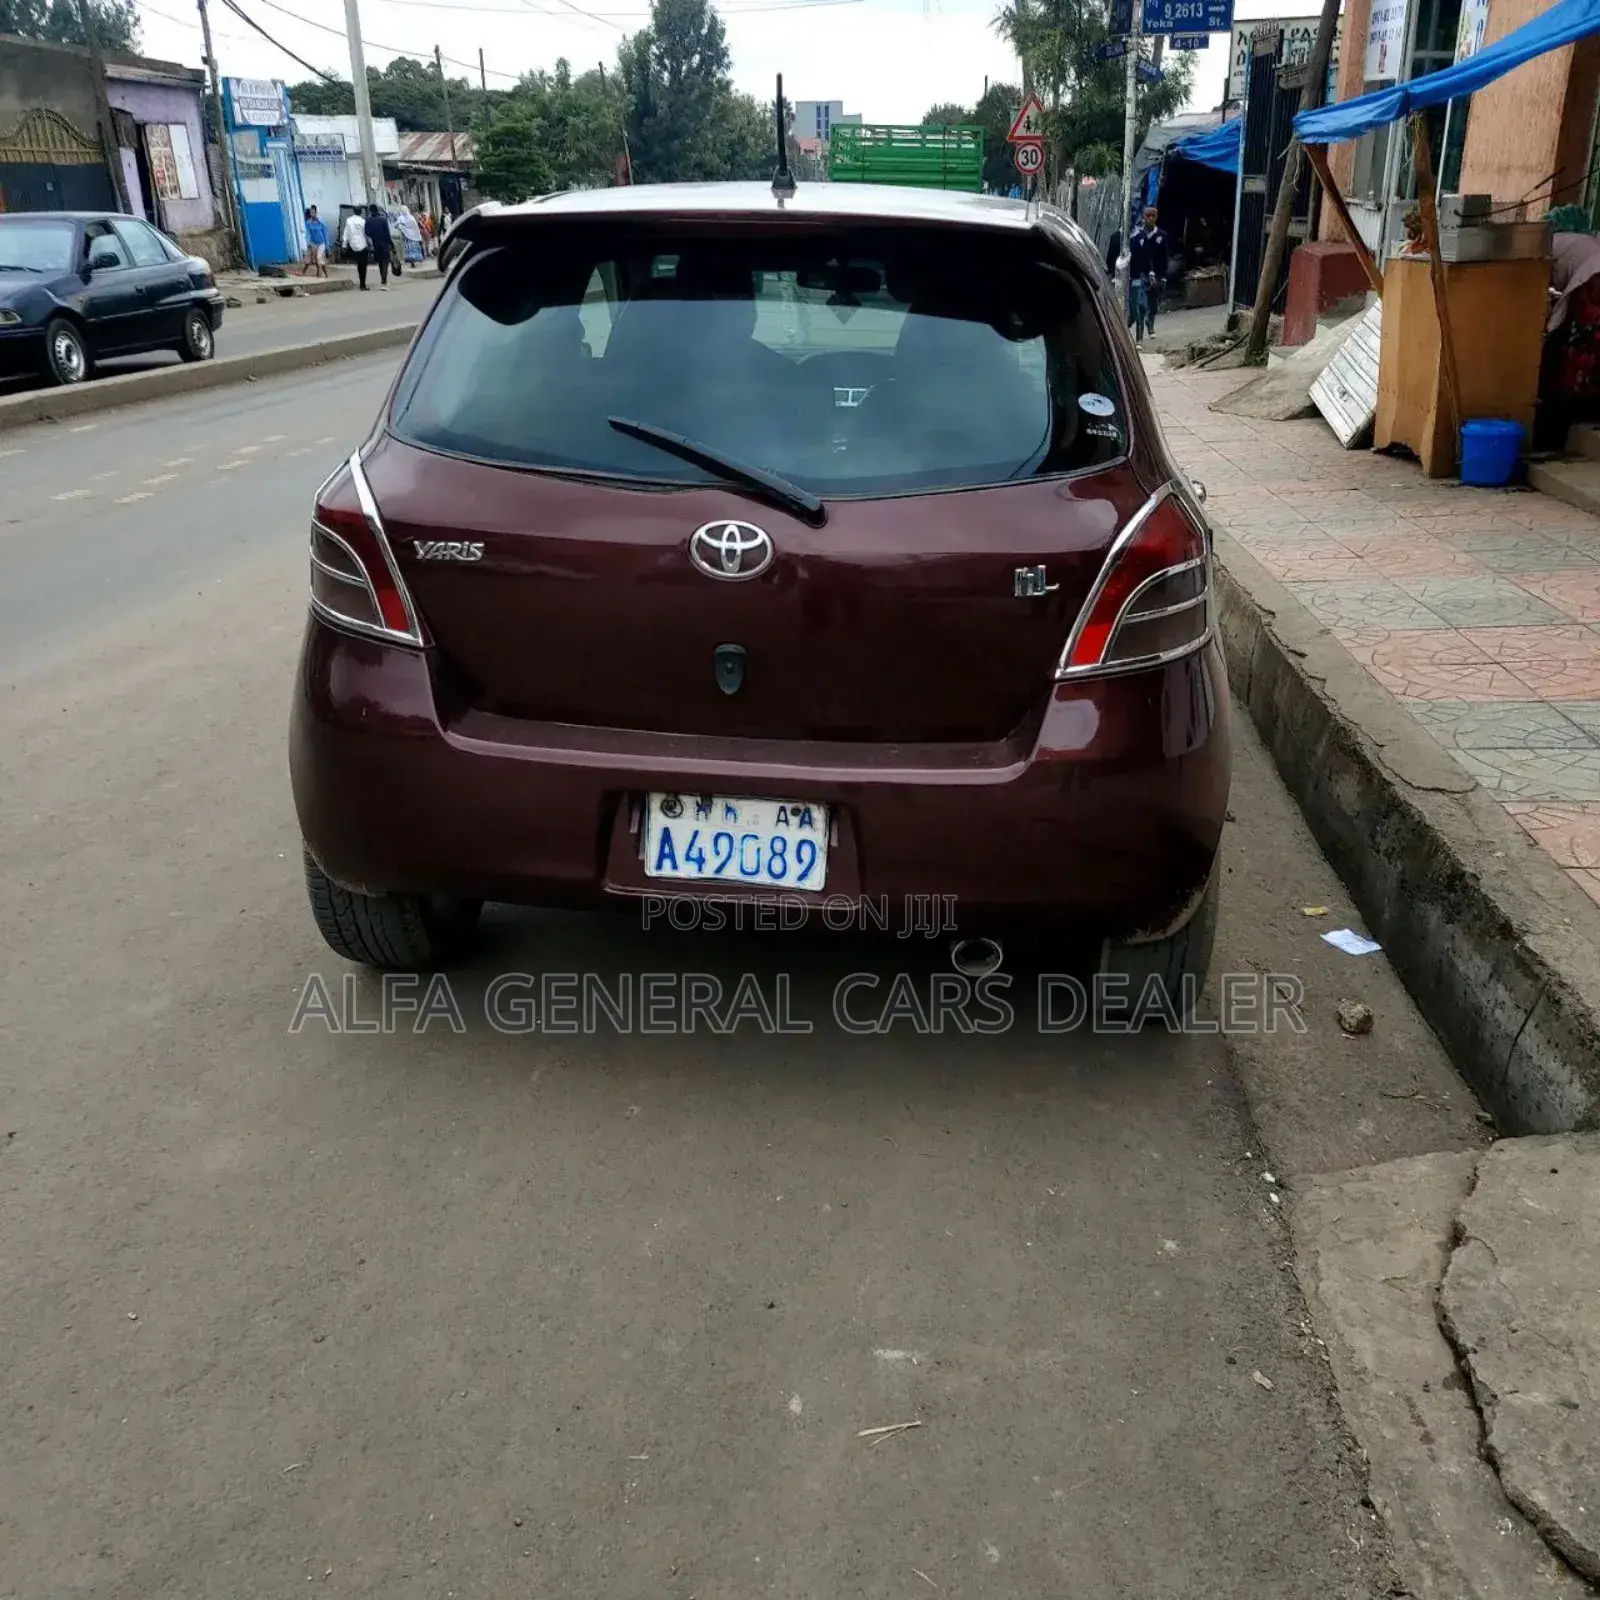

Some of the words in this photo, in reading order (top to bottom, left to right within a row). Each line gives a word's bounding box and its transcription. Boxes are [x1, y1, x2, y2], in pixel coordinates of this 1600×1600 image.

[1146, 20, 1174, 28] Yeka
[1208, 17, 1225, 27] St.
[1021, 149, 1038, 166] 30
[655, 826, 817, 882] A49089
